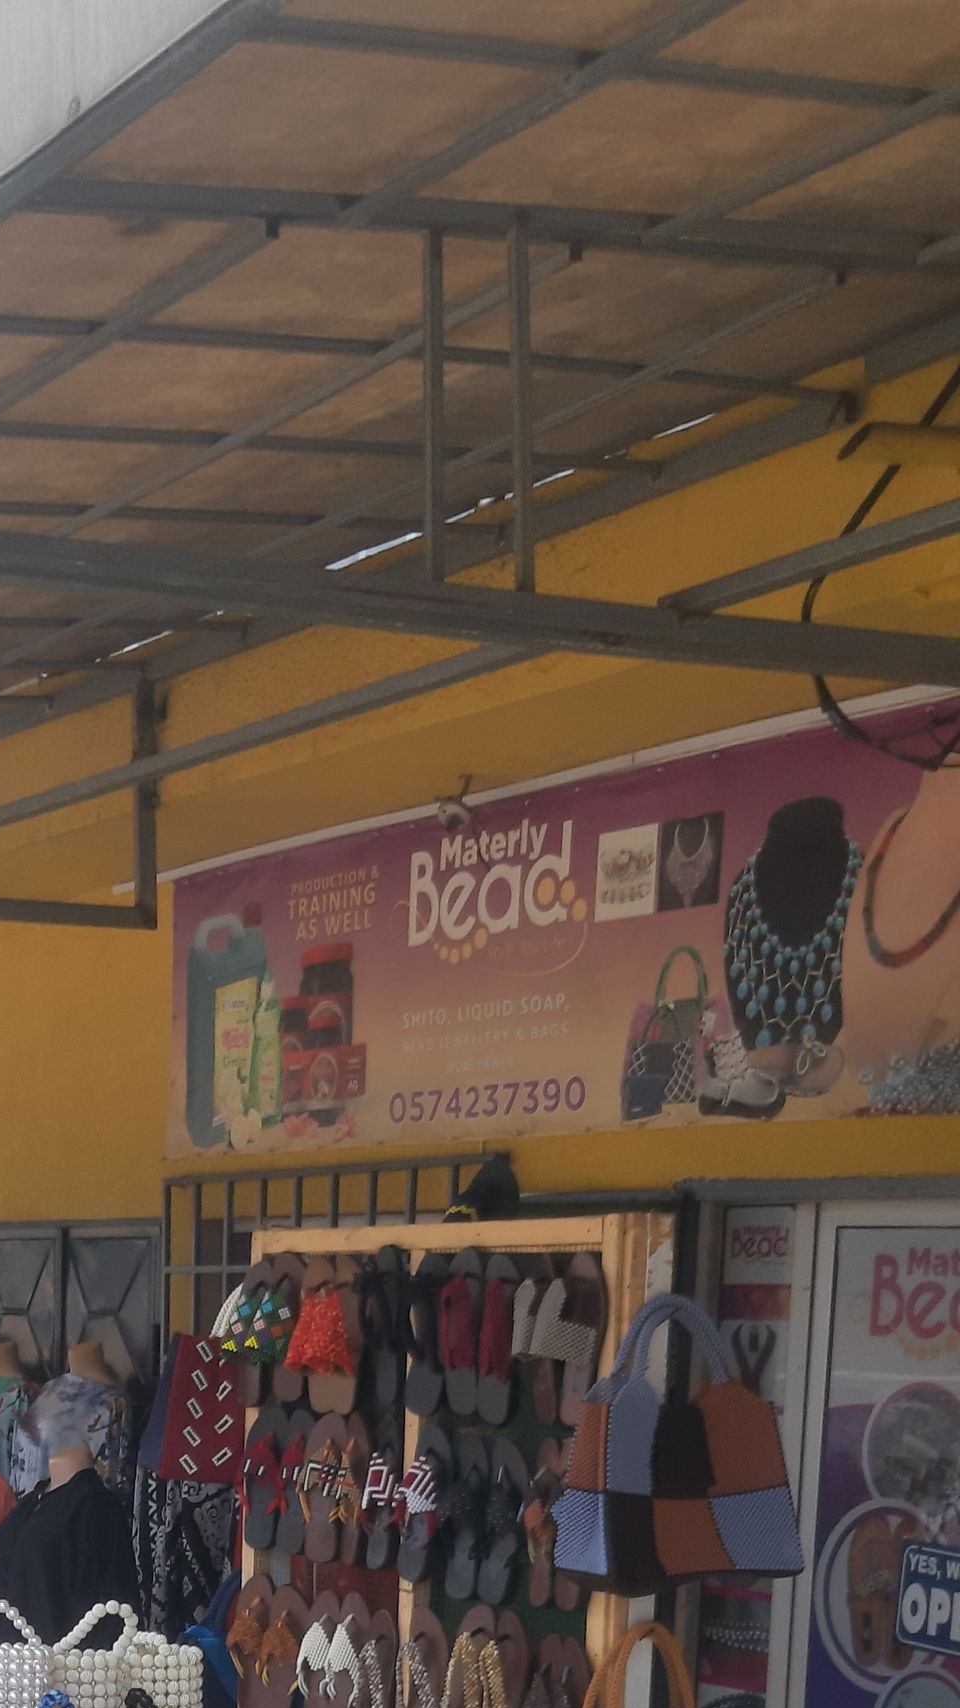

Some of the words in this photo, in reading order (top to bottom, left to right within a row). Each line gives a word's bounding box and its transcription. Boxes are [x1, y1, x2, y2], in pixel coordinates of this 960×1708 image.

[440, 818, 547, 871] Materly
[290, 868, 367, 897] PRODUCTION
[370, 865, 380, 880] &
[407, 819, 574, 947] Bead
[287, 882, 376, 920] TRAINING
[296, 918, 318, 942] AS
[324, 908, 374, 936] WELL
[457, 1000, 513, 1022] LIQUID
[520, 992, 571, 1015] SOAP,
[530, 1021, 569, 1041] BAGS
[389, 1076, 586, 1124] 0574237390
[869, 1252, 960, 1339] Be
[909, 1553, 940, 1580] YES,
